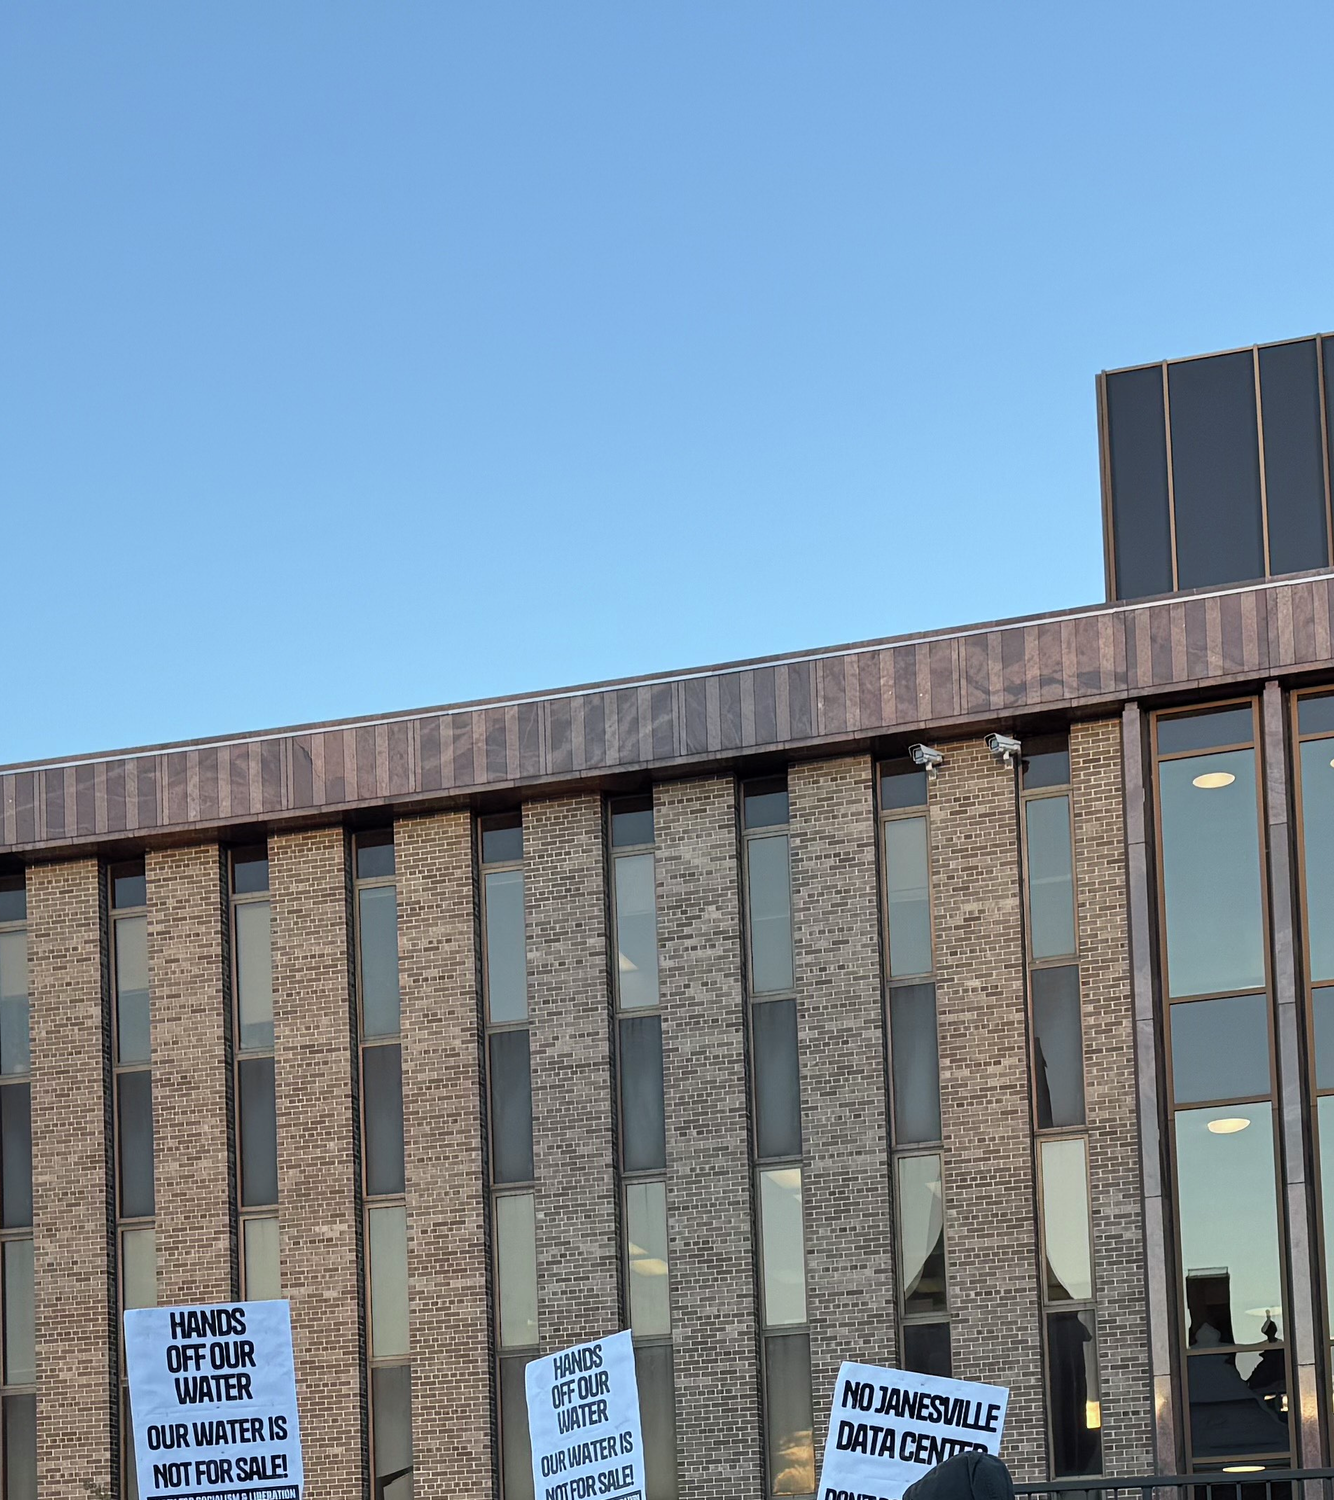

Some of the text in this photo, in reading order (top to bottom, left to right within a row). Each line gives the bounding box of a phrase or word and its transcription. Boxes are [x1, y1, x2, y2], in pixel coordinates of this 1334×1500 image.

[170, 1308, 246, 1340] HANDS
[167, 1341, 256, 1373] OFF OUR
[553, 1344, 602, 1380] HANDS
[174, 1373, 253, 1404] WATER
[552, 1371, 610, 1409] OFF OUR
[557, 1399, 609, 1434] WATER
[841, 1380, 1001, 1433] NO JANESVILLE
[147, 1416, 288, 1450] OUR WATER IS
[836, 1420, 895, 1460] DATA
[153, 1454, 288, 1489] NOT FOR SALE!
[541, 1431, 633, 1477] OUR WATER IS
[249, 1489, 296, 1500] LIBERATION
[571, 1475, 596, 1500] FOR
[598, 1464, 634, 1495] SALE!
